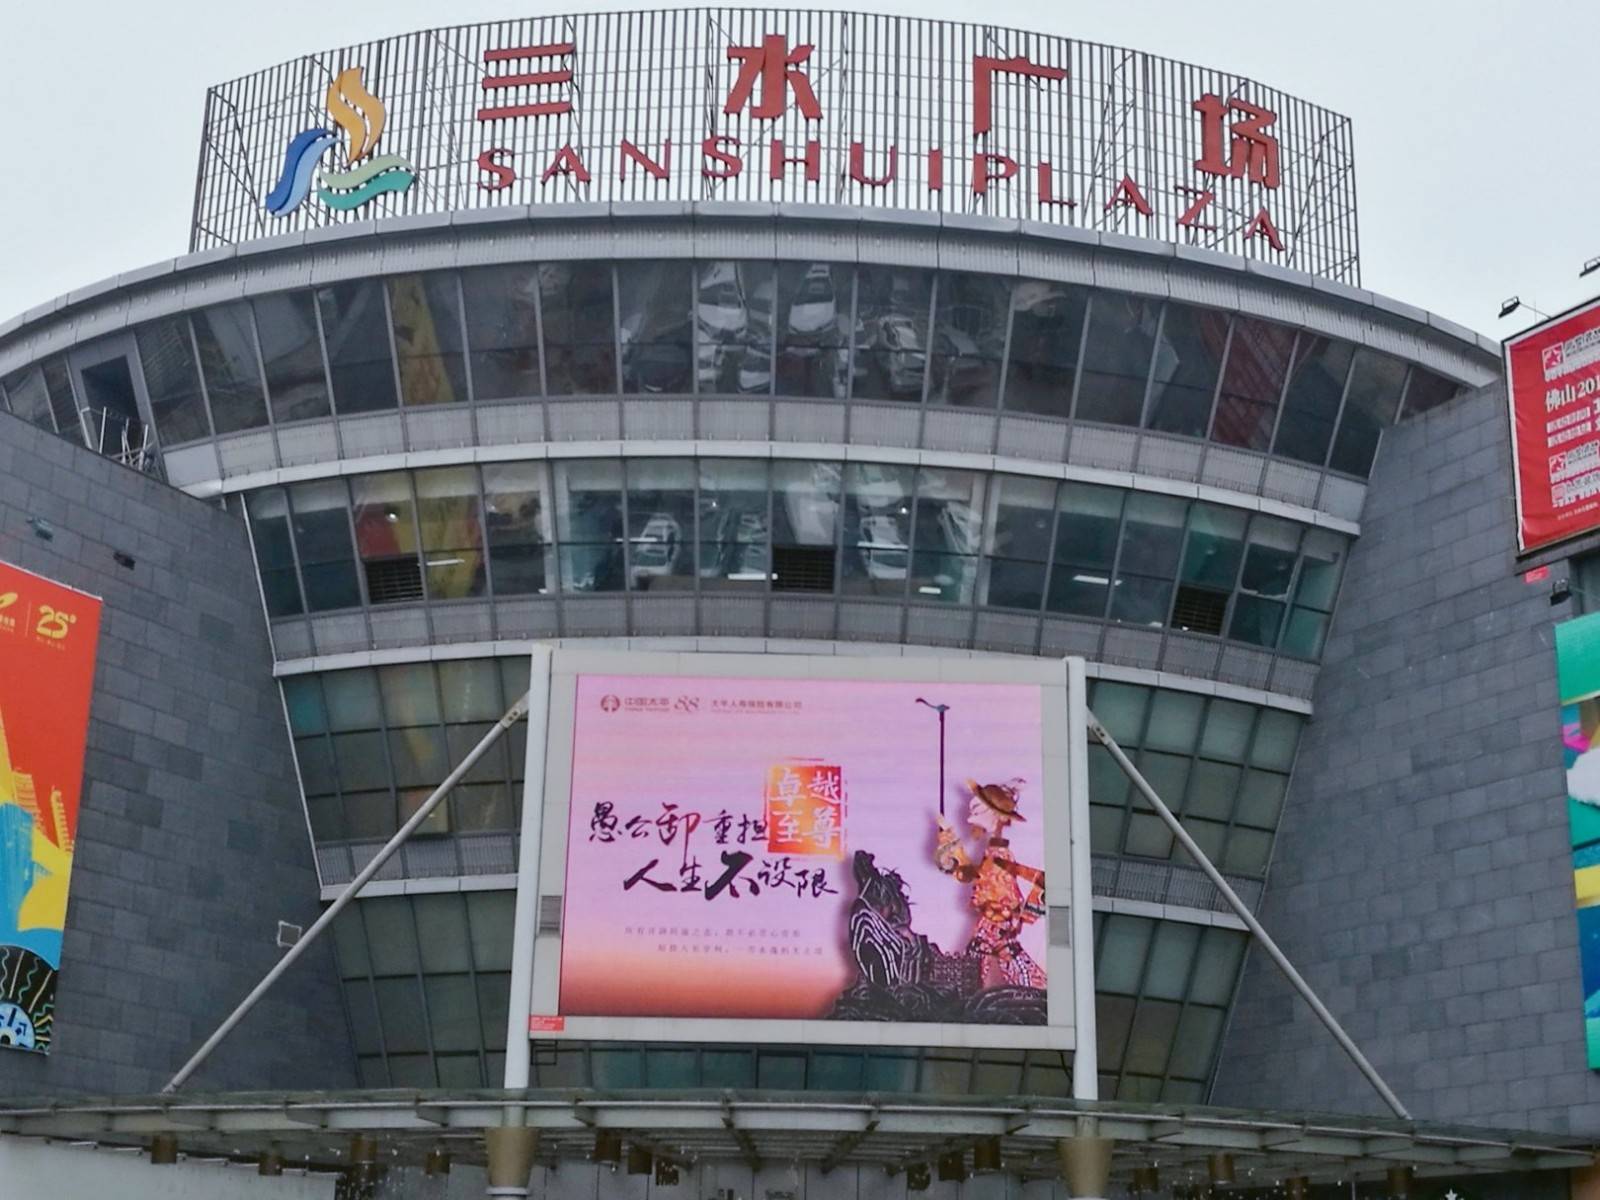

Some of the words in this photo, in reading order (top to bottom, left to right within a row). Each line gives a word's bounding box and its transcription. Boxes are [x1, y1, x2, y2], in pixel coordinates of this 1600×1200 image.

[477, 34, 1278, 190] 三水广场
[623, 850, 839, 901] 人生不设限
